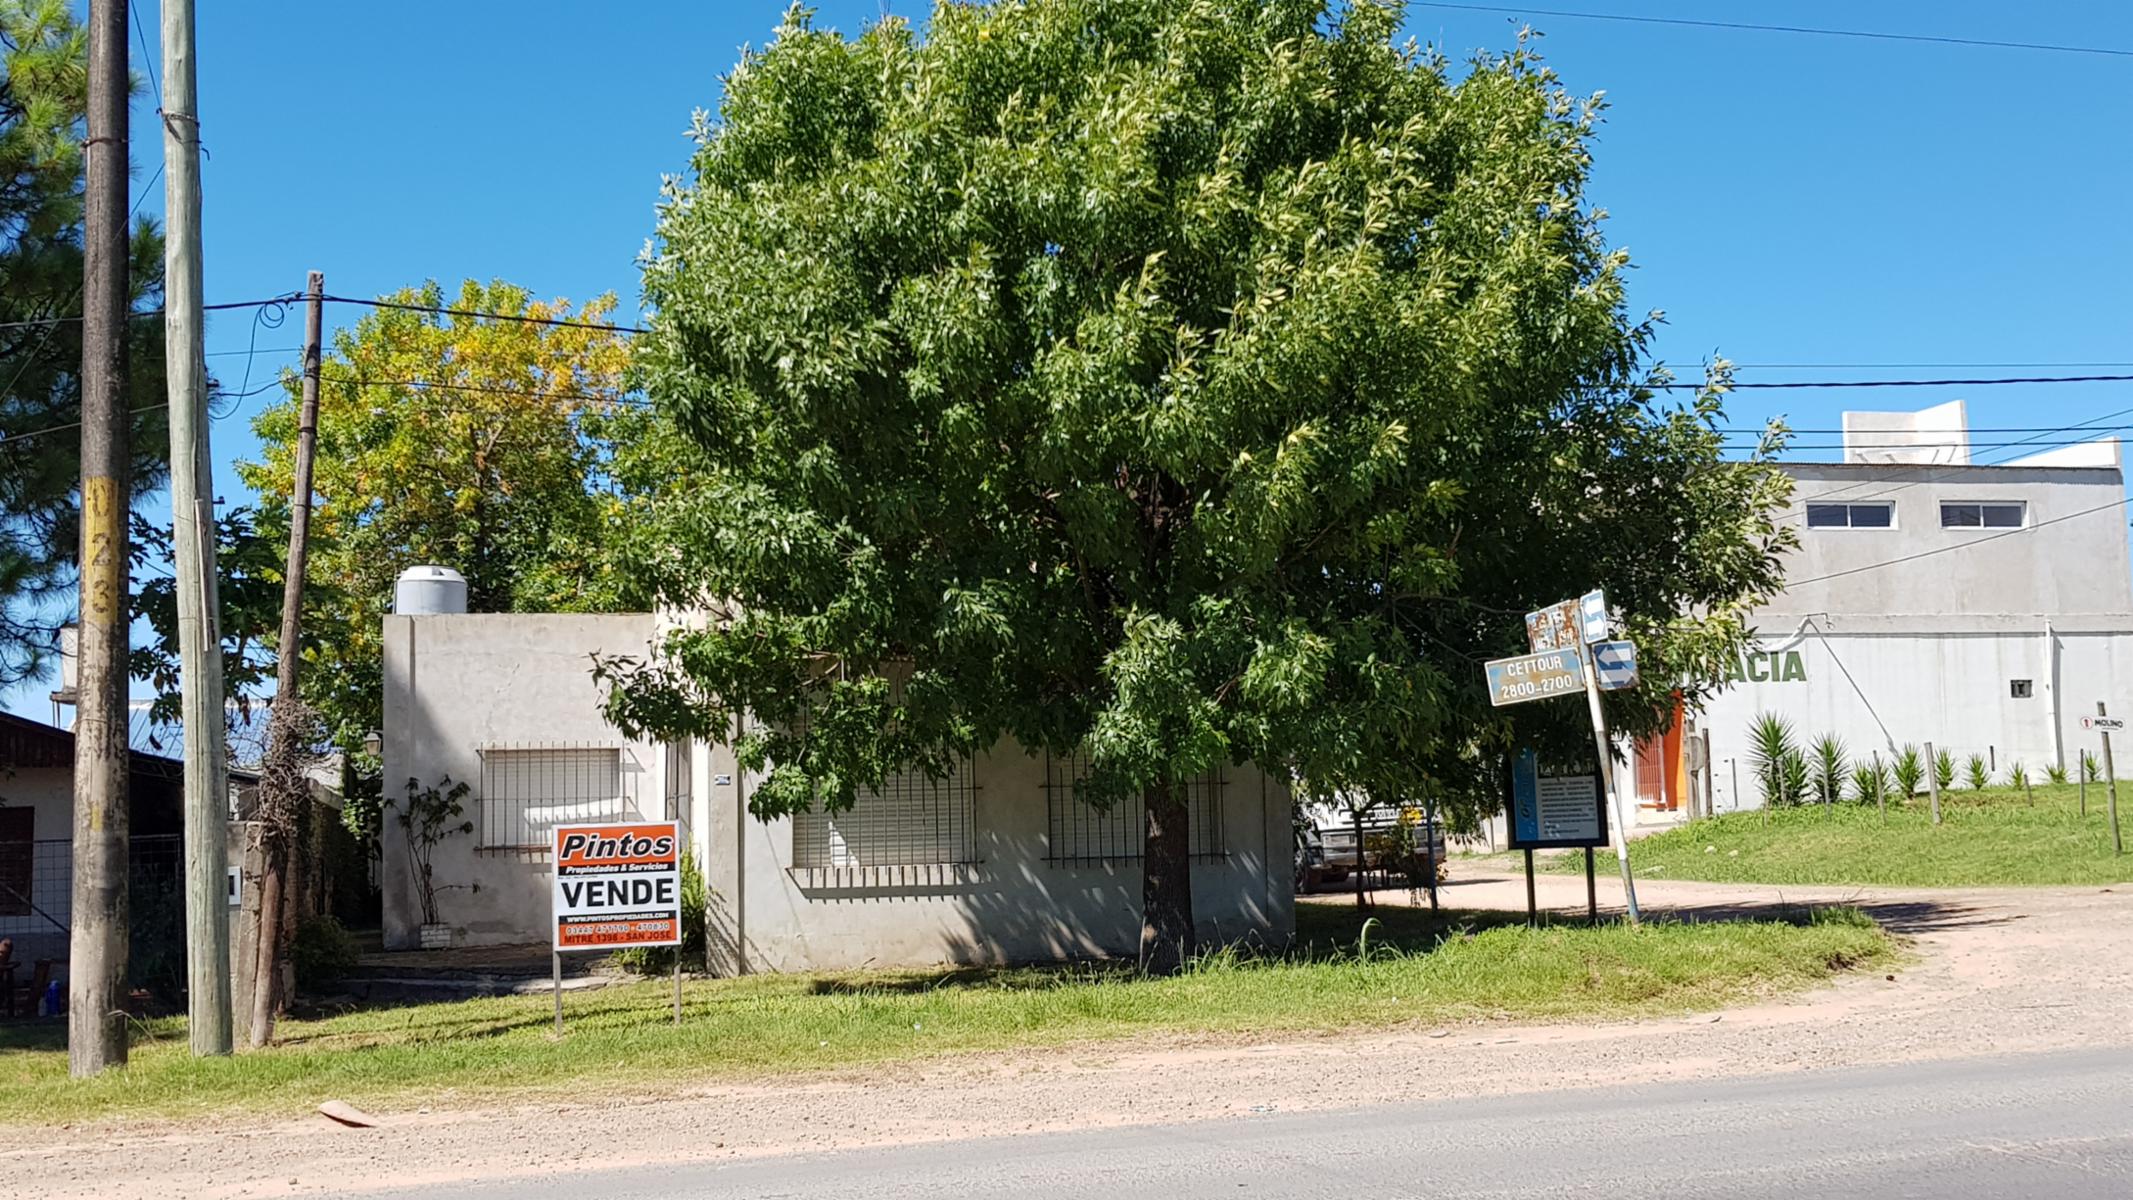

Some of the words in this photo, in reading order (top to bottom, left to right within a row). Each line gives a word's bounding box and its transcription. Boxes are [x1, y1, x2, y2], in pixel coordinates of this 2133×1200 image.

[1507, 656, 1563, 677] CETTOUR
[1501, 674, 1573, 699] 2800-2700
[2094, 719, 2123, 728] MOLINO
[560, 832, 674, 860] Pintos
[566, 864, 619, 874] Propiedades
[629, 862, 669, 871] Servicios
[561, 878, 675, 908] VENDE
[564, 933, 594, 944] MITRE
[626, 931, 645, 941] SAN
